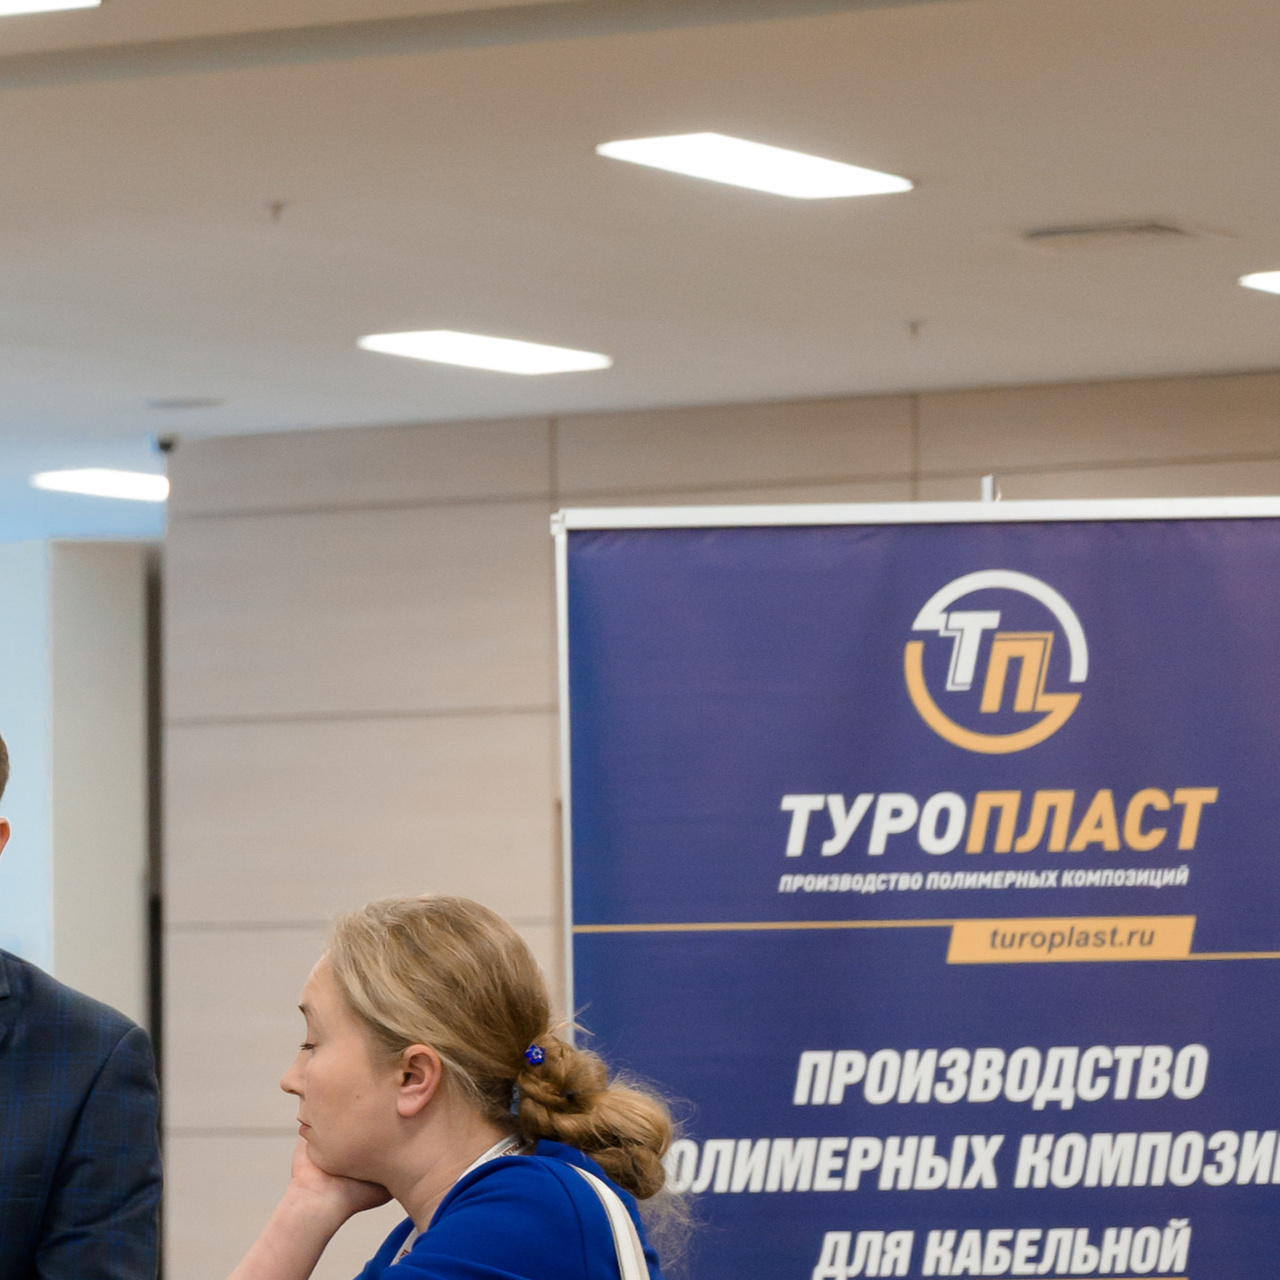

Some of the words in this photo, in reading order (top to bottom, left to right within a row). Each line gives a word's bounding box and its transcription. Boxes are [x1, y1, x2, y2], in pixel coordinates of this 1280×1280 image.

[779, 787, 1218, 857] ТУРОПЛАСТ
[778, 873, 923, 894] ПРОИЗВОДСТВО
[925, 869, 1057, 891] ПОЛИМЕРНЫХ
[1061, 864, 1190, 888] КОМПОЗИЦИЙ
[989, 925, 1156, 952] turoplast.ru
[793, 1045, 1210, 1110] ПРОИЗВОДСТВО
[663, 1135, 1005, 1193] ОЛИМЕРНЫХ
[1014, 1130, 1280, 1189] КОМПОЗИ
[922, 1218, 1192, 1277] КАБЕЛЬНОЙ
